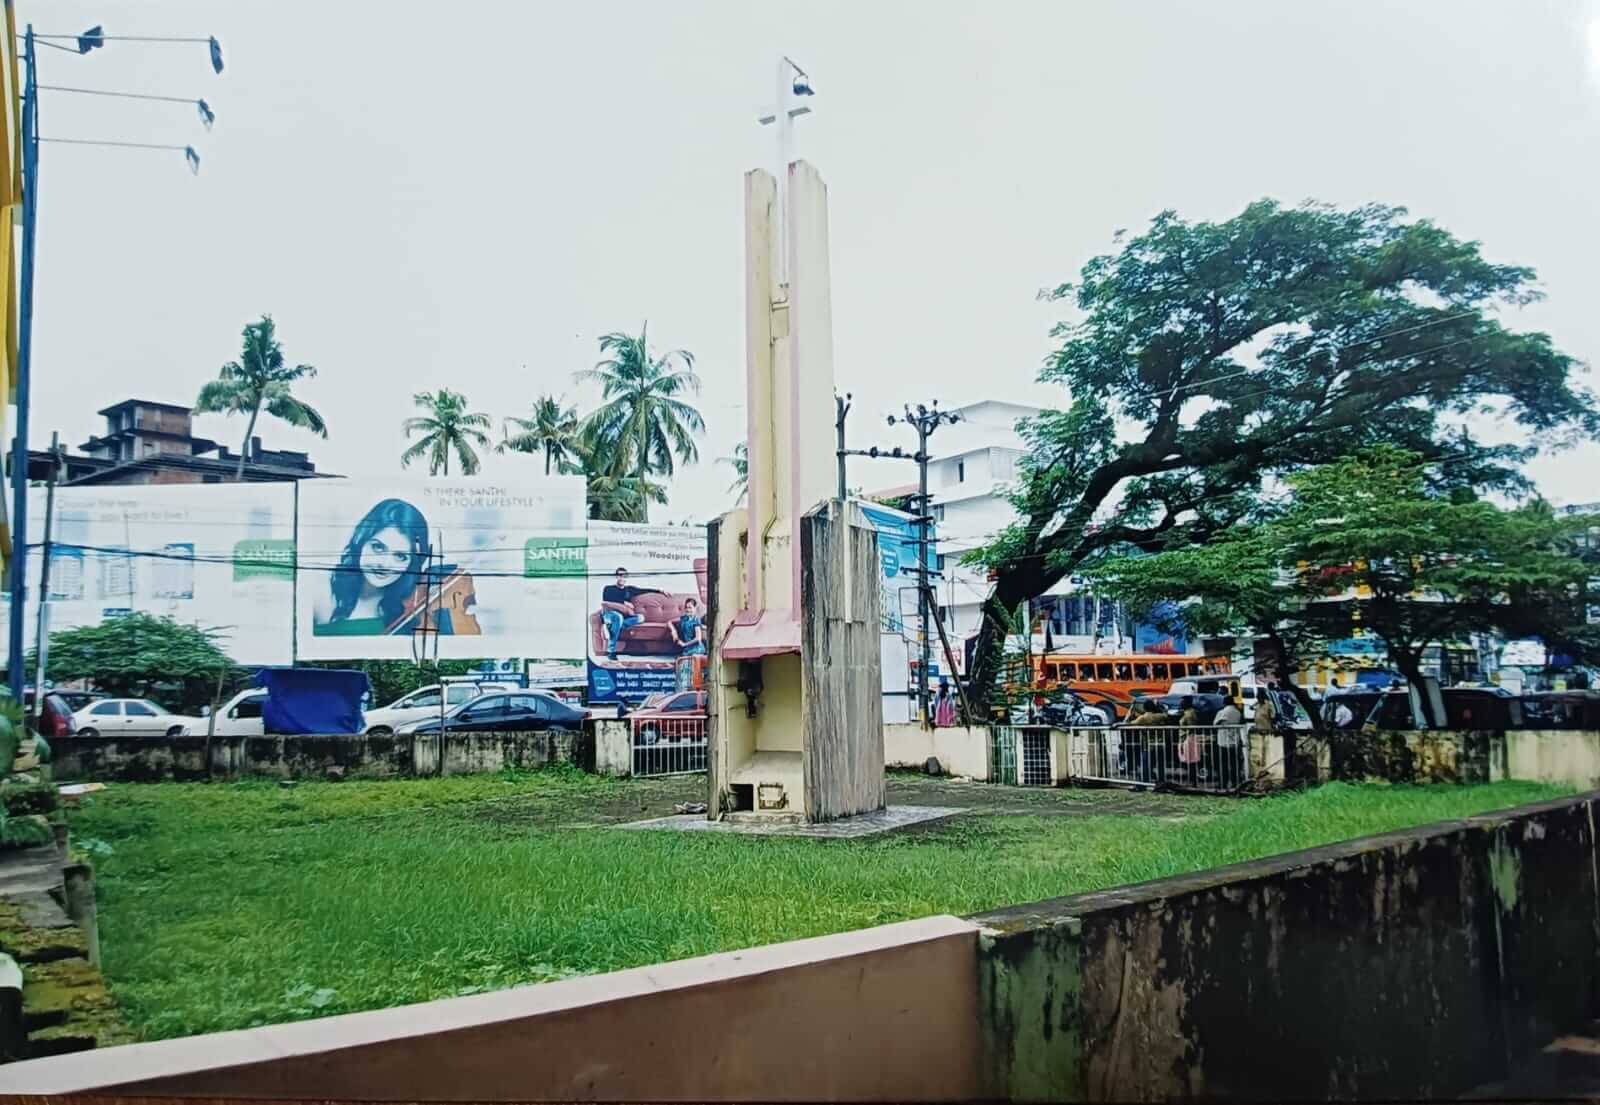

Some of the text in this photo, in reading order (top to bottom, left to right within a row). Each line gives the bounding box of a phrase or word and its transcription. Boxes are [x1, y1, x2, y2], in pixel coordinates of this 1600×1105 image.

[436, 487, 465, 496] THERE
[469, 486, 506, 496] SANTHI
[455, 497, 484, 507] YOUR
[486, 497, 533, 507] LIFESTYLE
[528, 548, 585, 561] SANTHI
